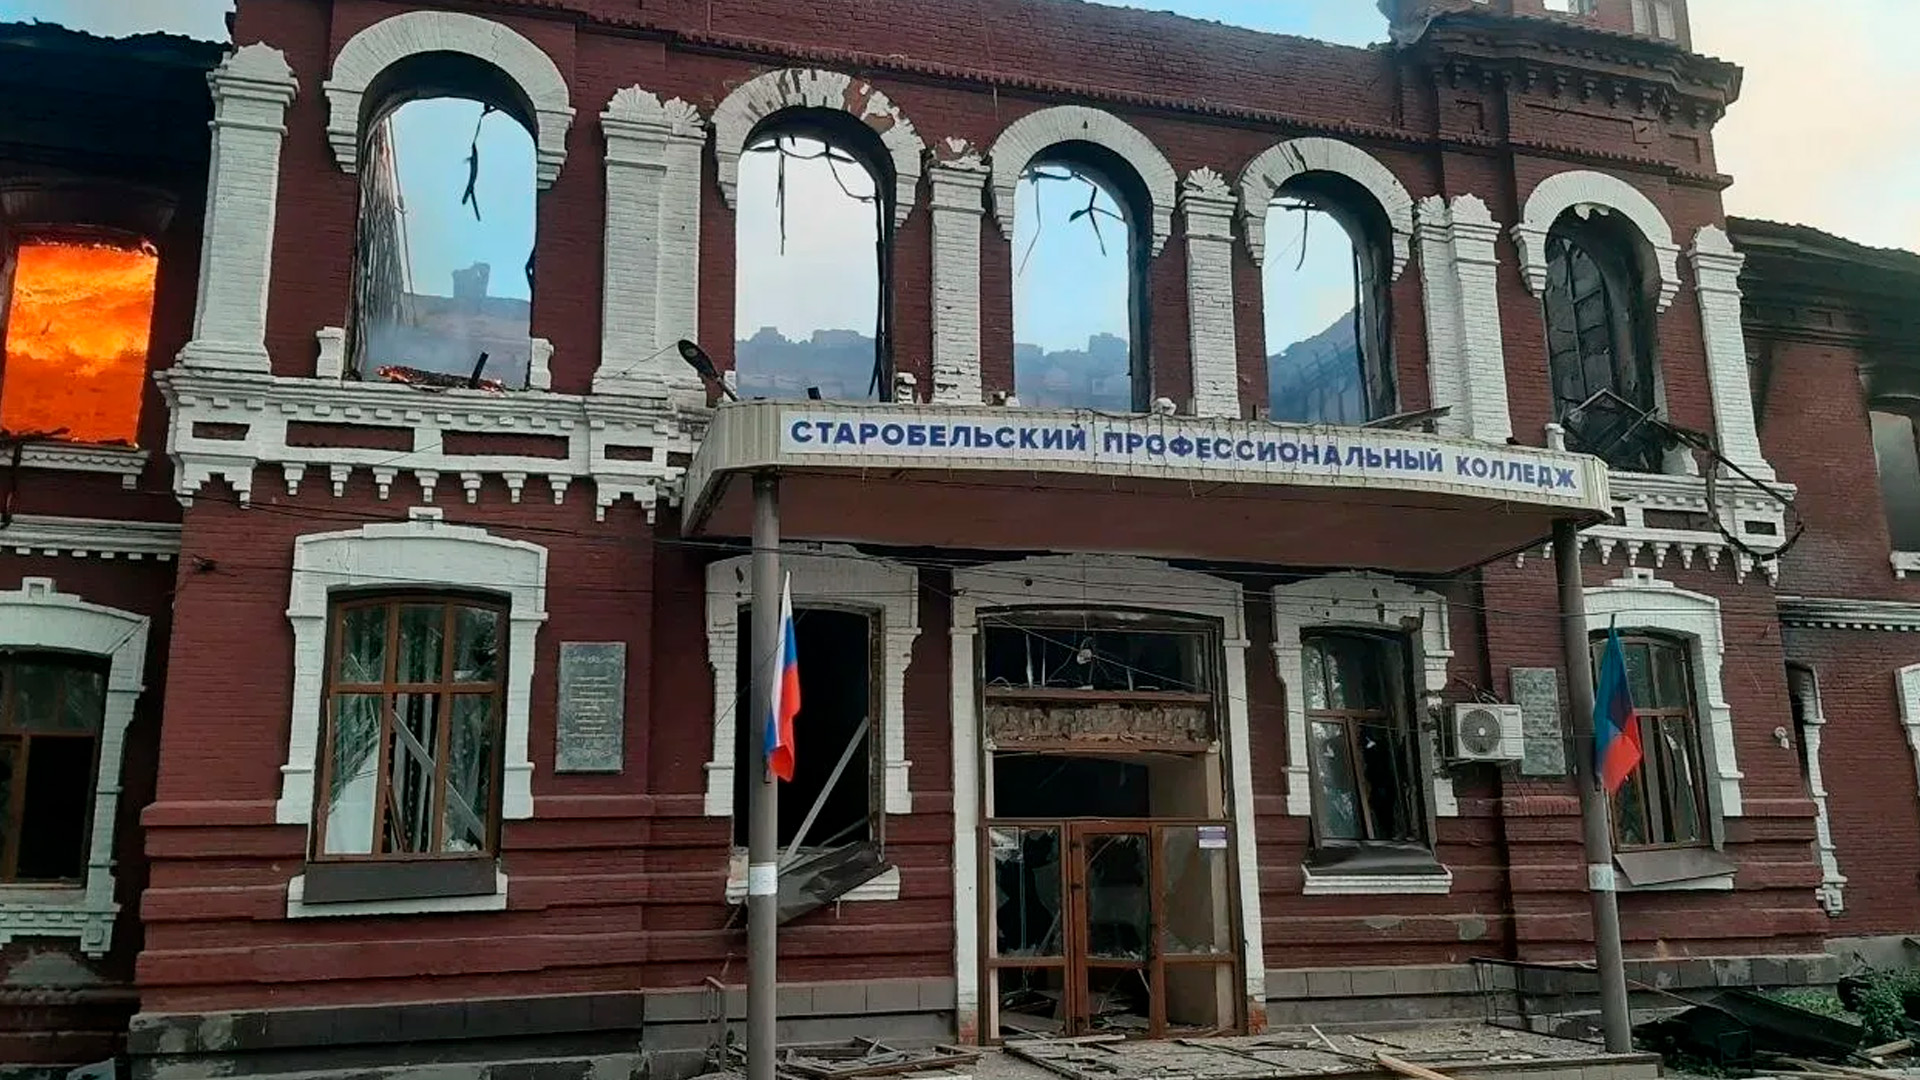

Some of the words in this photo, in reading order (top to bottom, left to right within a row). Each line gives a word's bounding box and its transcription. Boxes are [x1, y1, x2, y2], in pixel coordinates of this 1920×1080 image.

[790, 421, 1086, 452] СТАРОБЕЛЬСКИЙ
[1104, 431, 1443, 473] ПРОФЕССИОНАЛЬНЫЙ
[1456, 456, 1577, 490] КОЛЛЕДЖ
